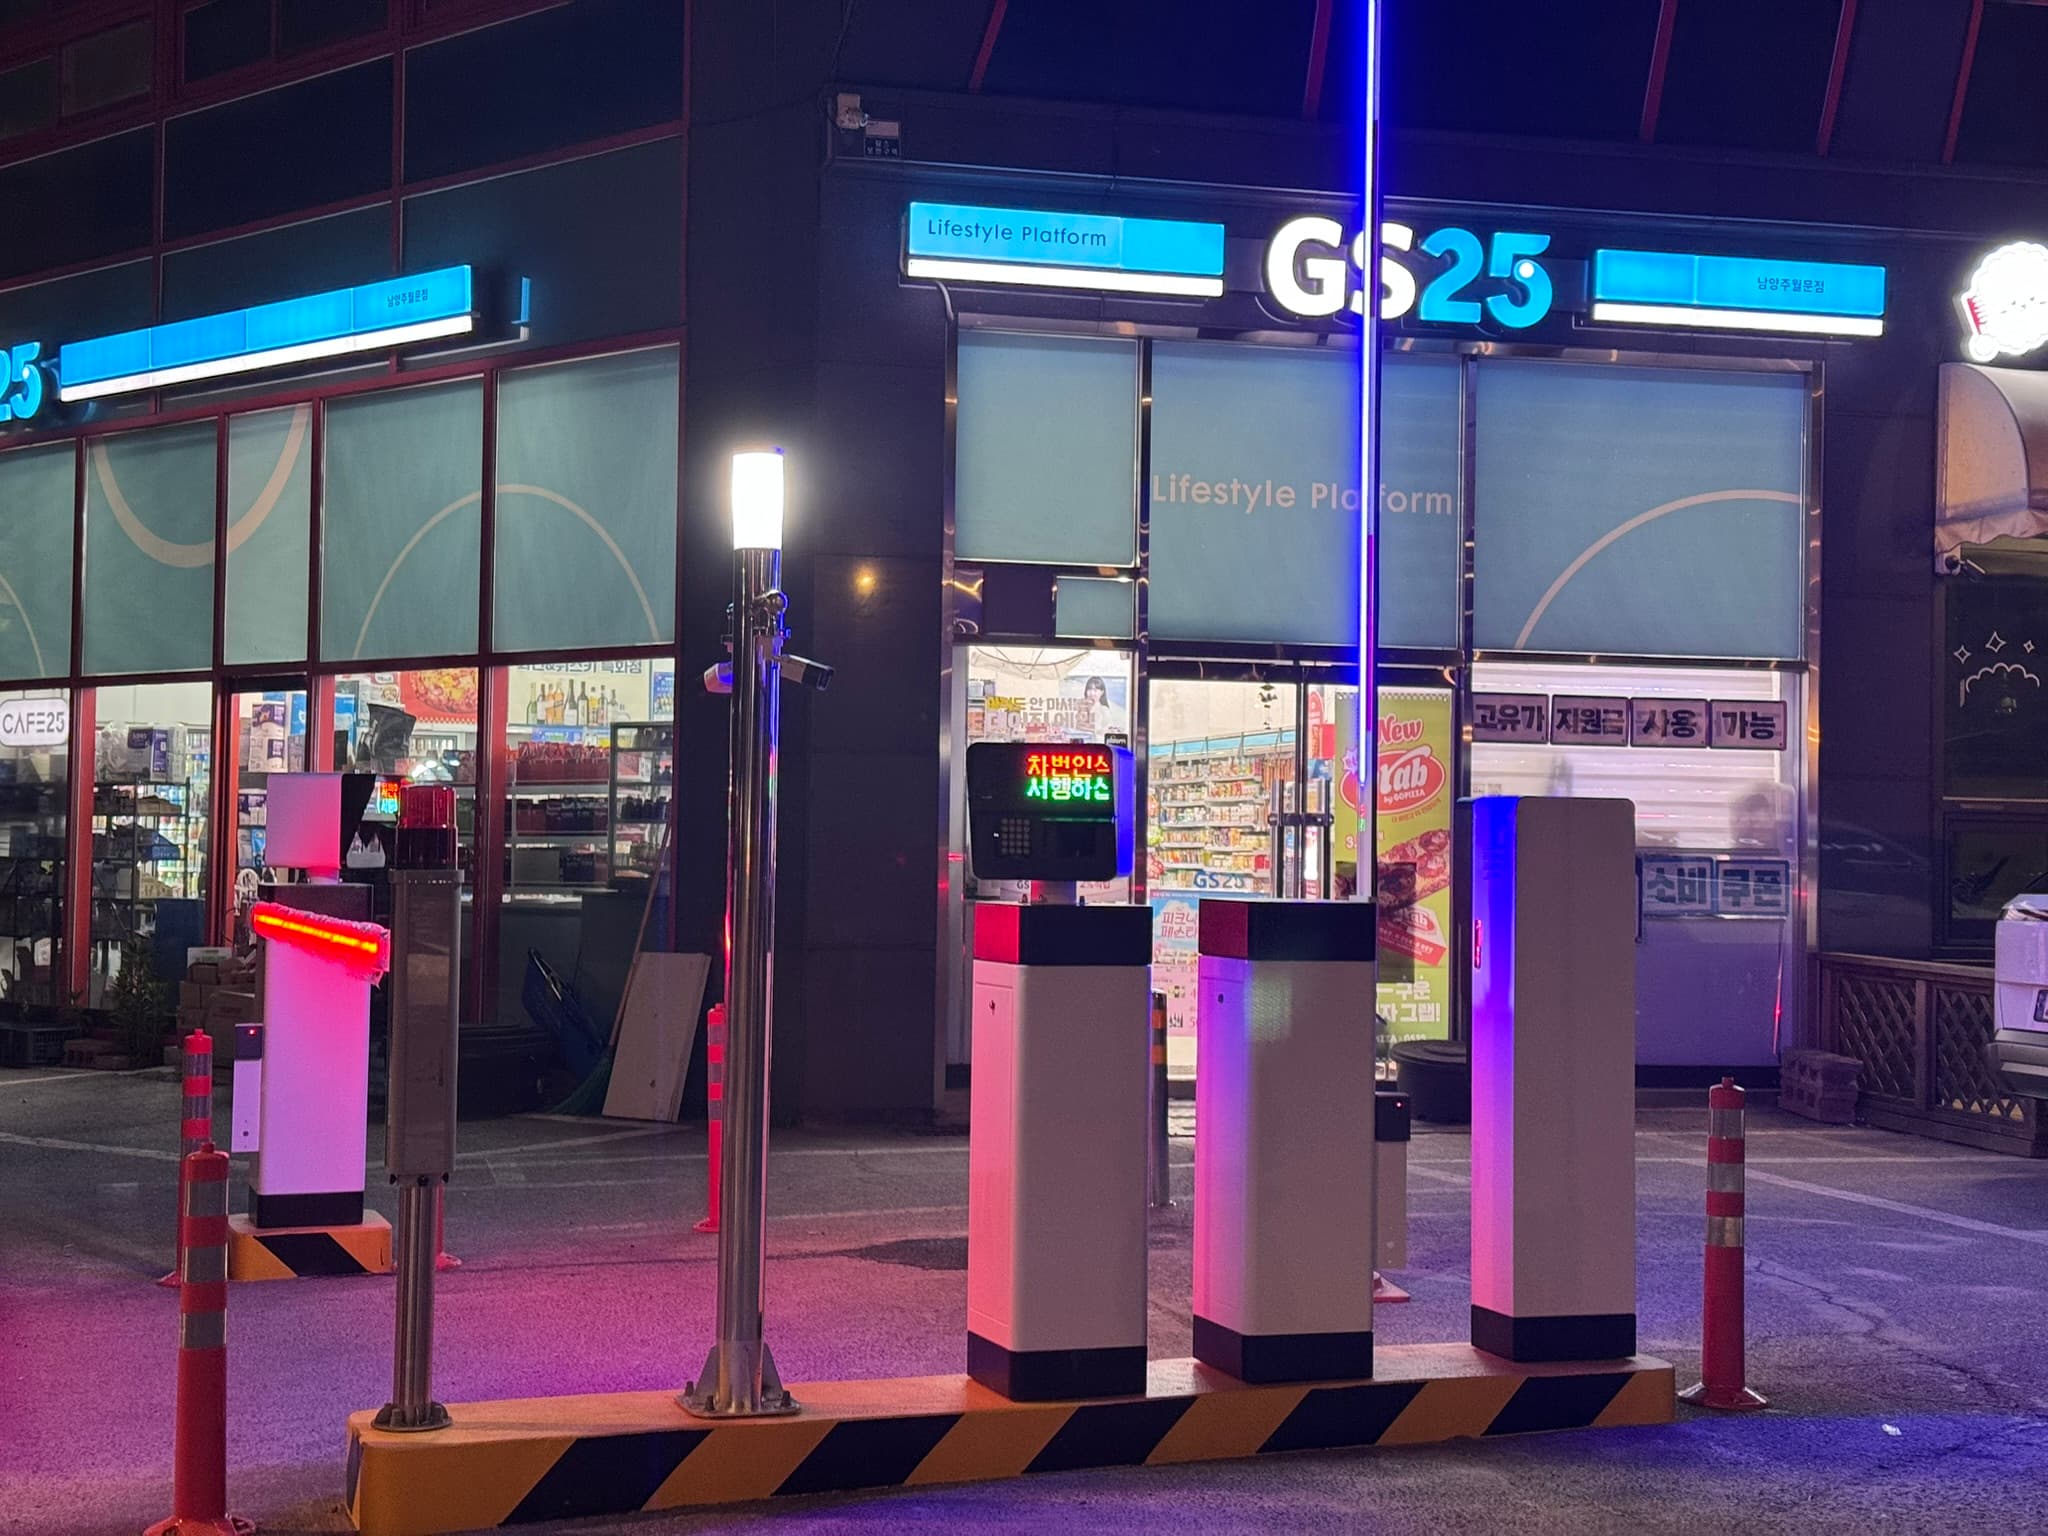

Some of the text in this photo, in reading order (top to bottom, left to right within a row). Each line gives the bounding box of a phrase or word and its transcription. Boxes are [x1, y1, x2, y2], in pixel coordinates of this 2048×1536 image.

[928, 219, 1107, 247] Lifestyle Platform
[1267, 217, 1553, 328] GS25
[1757, 277, 1825, 293] 남양주월문점
[1152, 474, 1453, 515] Lifestyle Plaform
[3, 711, 65, 734] CAFE25
[1378, 714, 1424, 744] New
[1474, 703, 1776, 740] 고유가 지원금 사용 가능
[1379, 747, 1431, 795] rab
